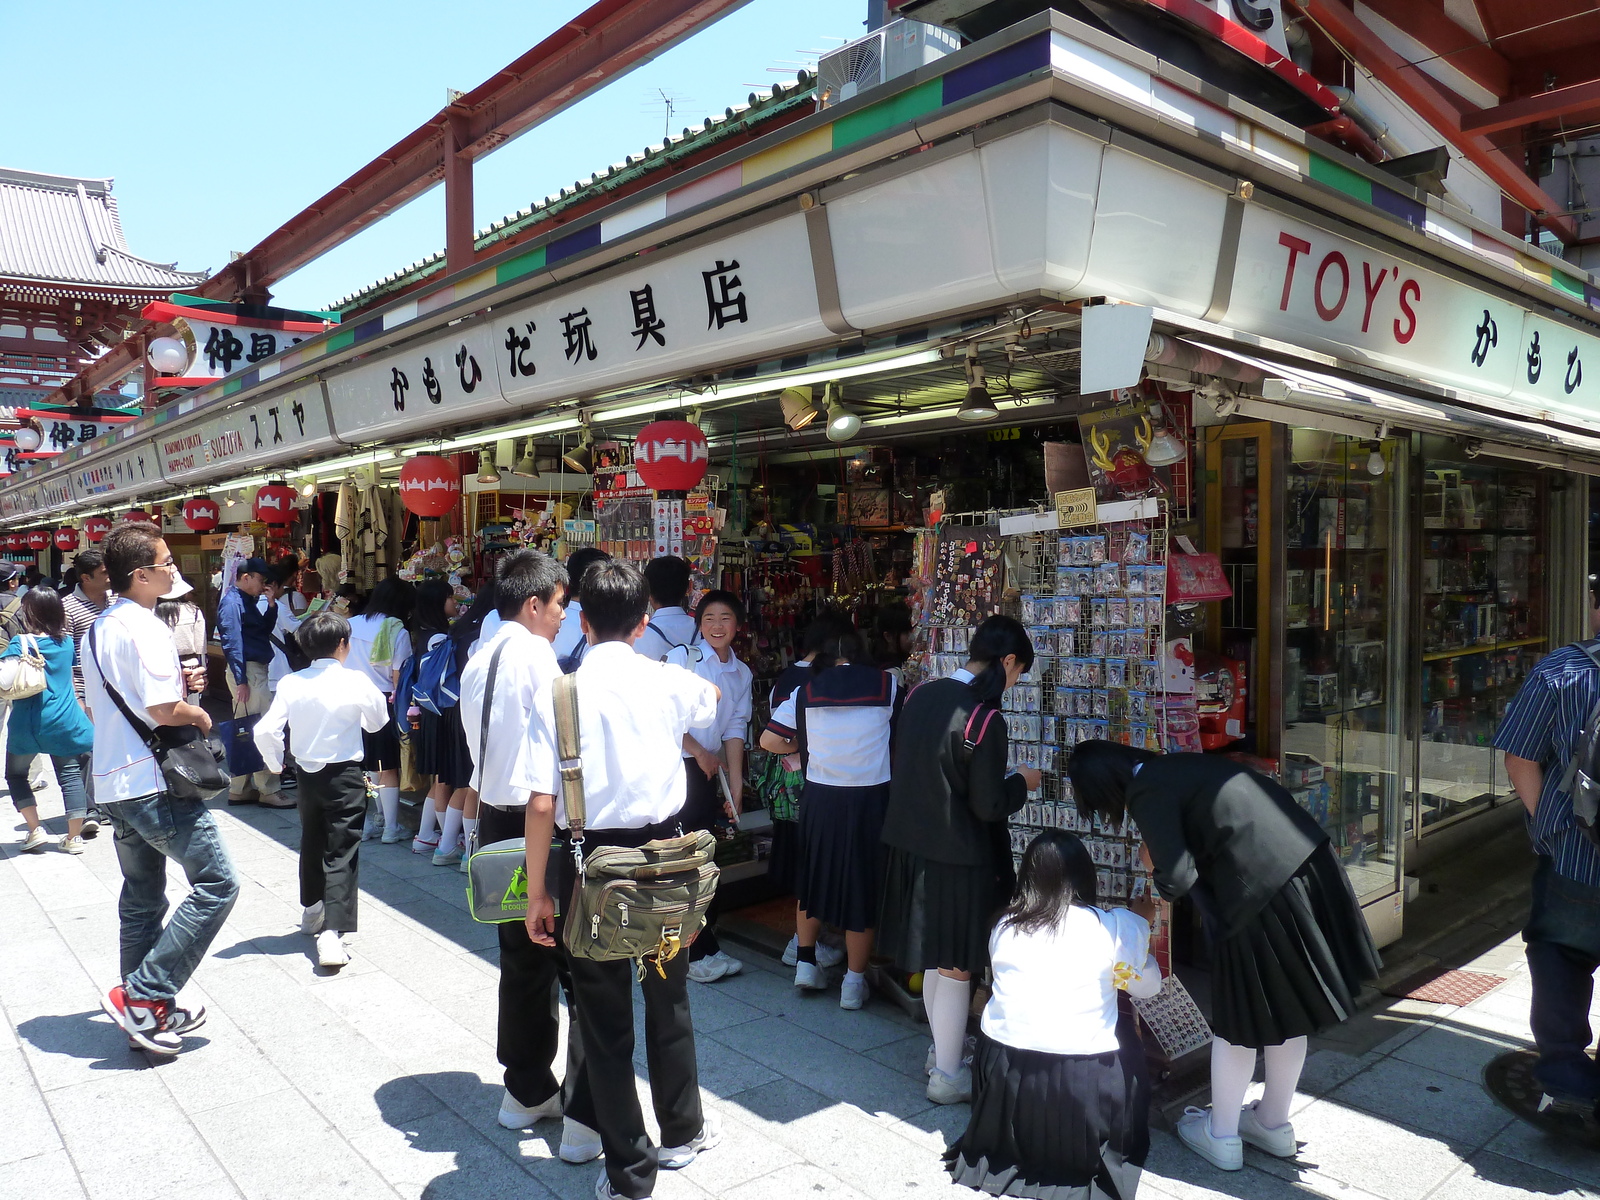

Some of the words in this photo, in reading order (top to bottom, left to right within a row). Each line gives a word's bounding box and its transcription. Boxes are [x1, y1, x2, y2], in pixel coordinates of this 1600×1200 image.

[204, 326, 303, 373] 仲見
[390, 259, 748, 412] かもひだ玩具店
[1278, 231, 1421, 345] TOY'S
[1470, 309, 1583, 395] かもひ
[210, 430, 244, 459] SUZUYA
[249, 400, 305, 450] スズヤ
